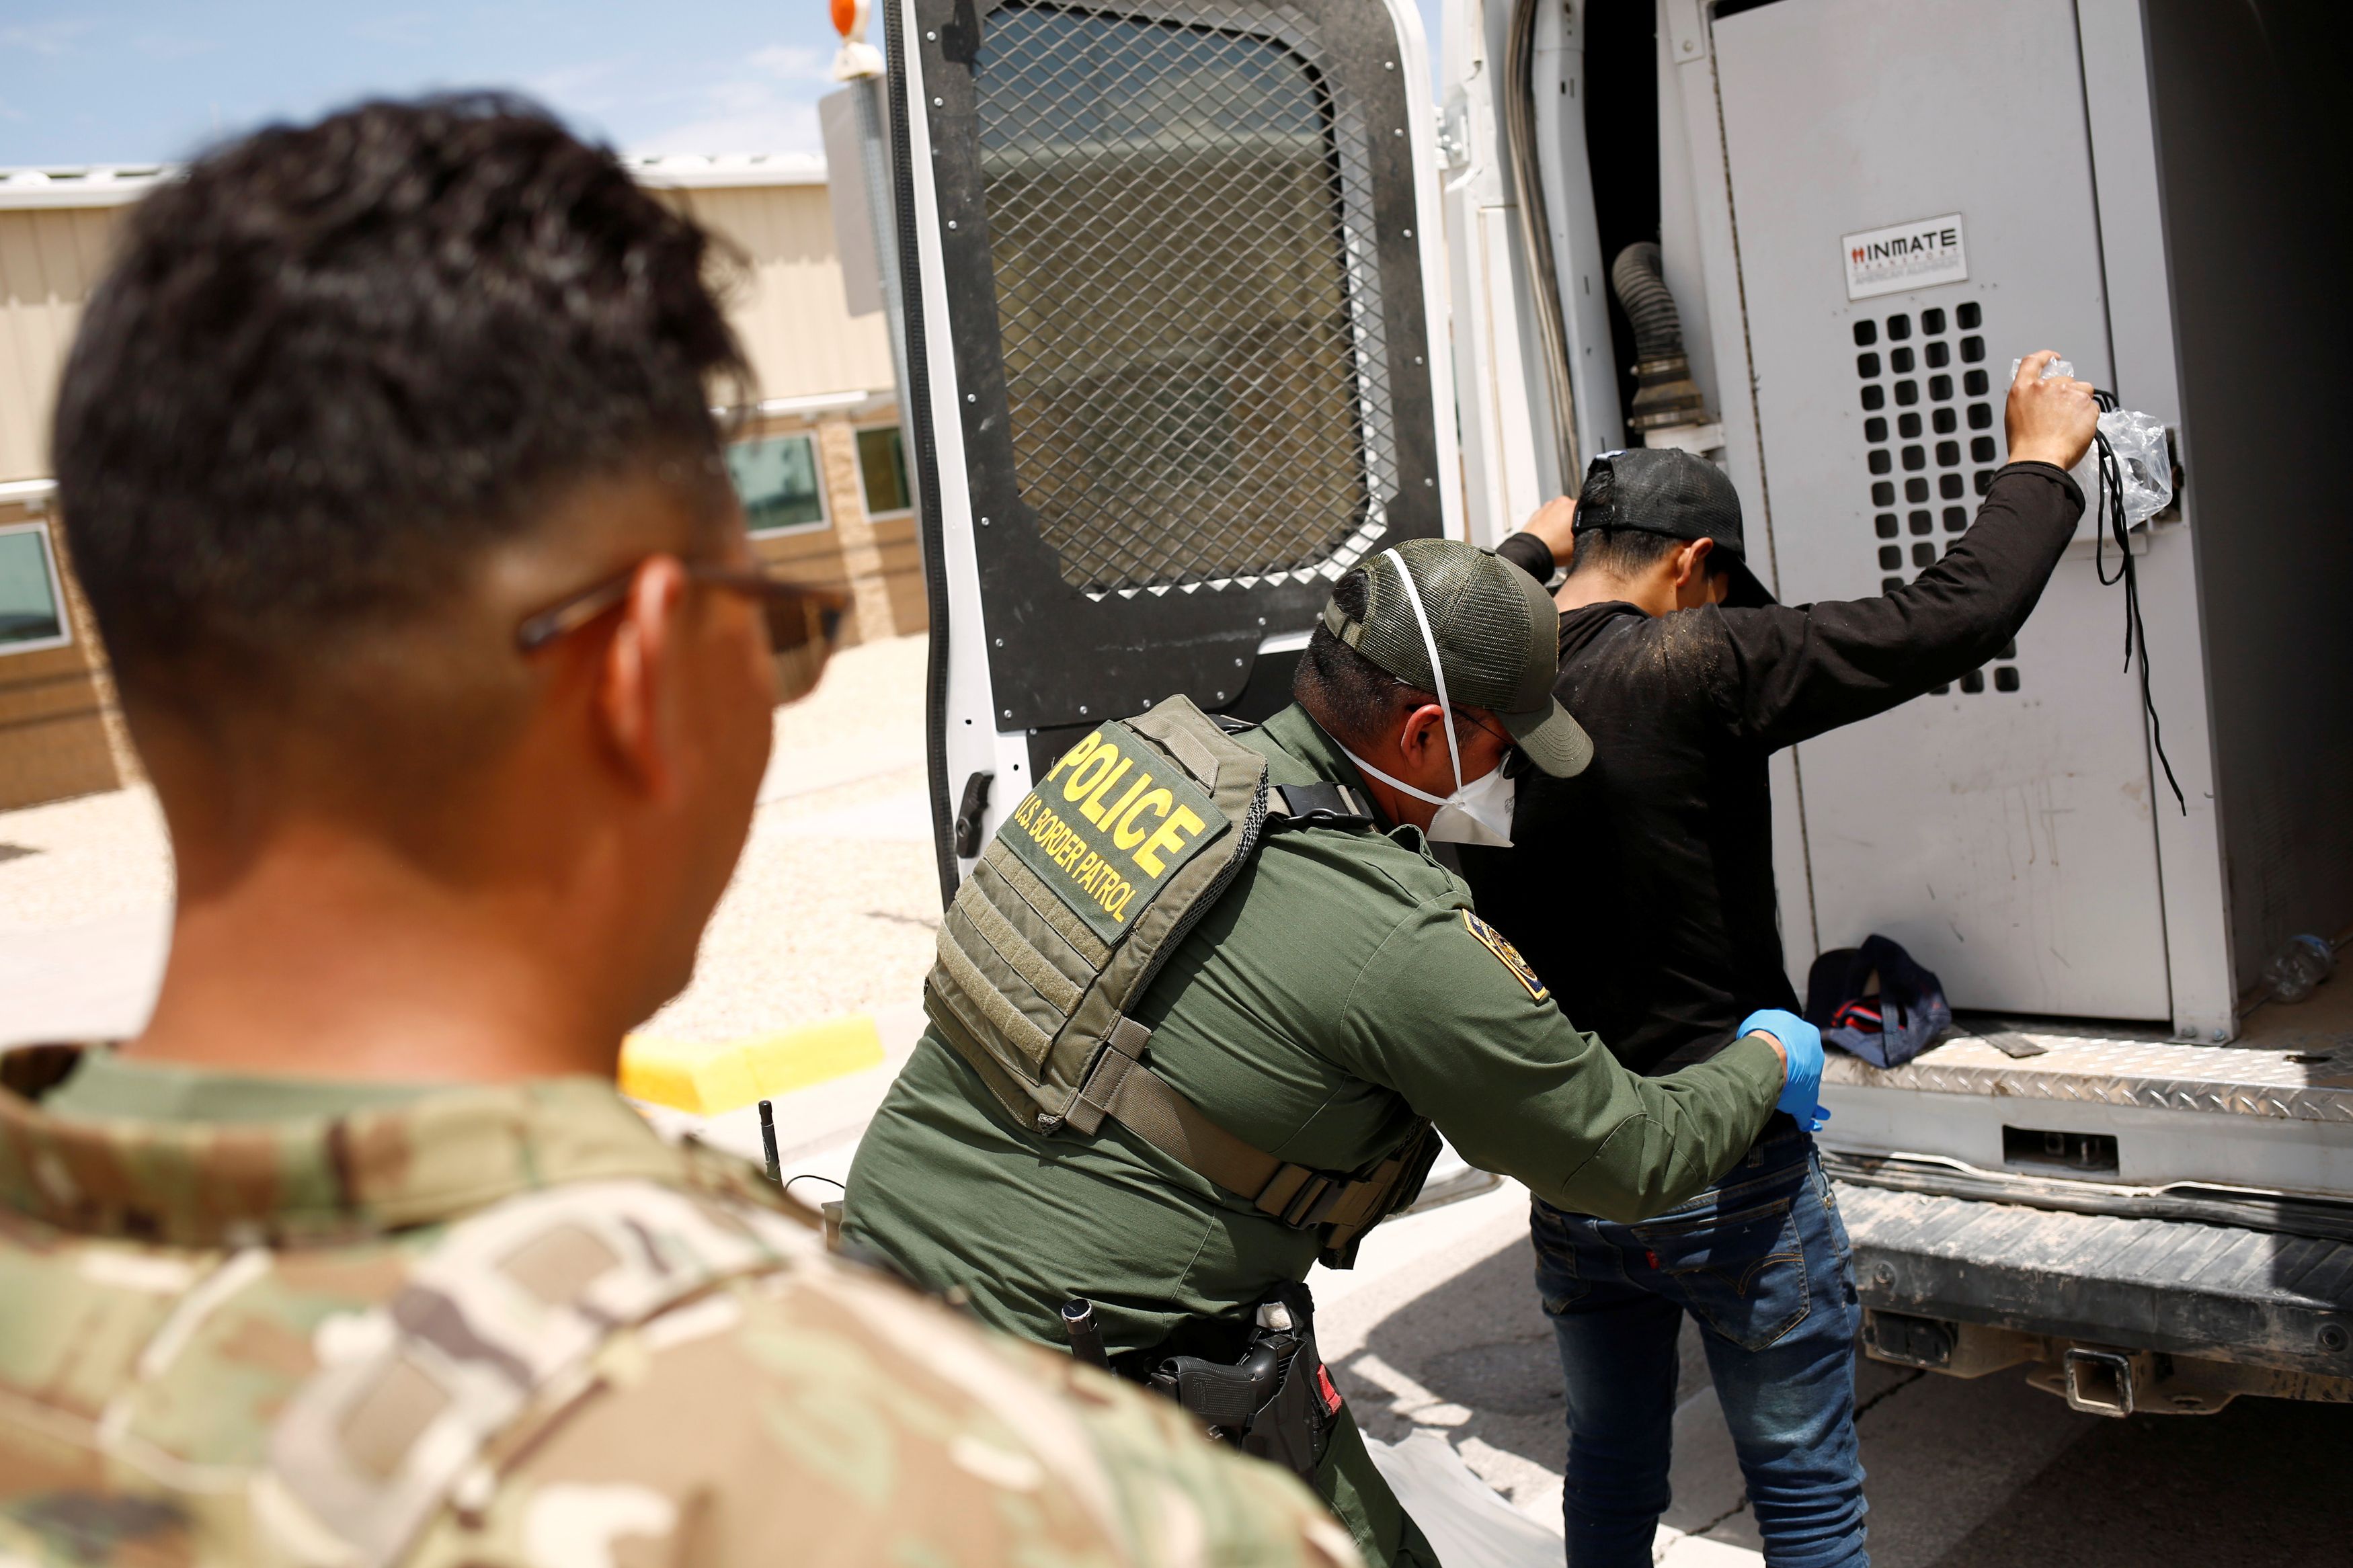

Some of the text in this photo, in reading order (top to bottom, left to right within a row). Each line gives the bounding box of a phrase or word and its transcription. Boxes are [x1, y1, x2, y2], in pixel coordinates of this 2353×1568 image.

[1867, 228, 1957, 261] INMATE
[1014, 792, 1136, 923] U.S. BORDER PATROL
[1047, 731, 1205, 879] POLICE
